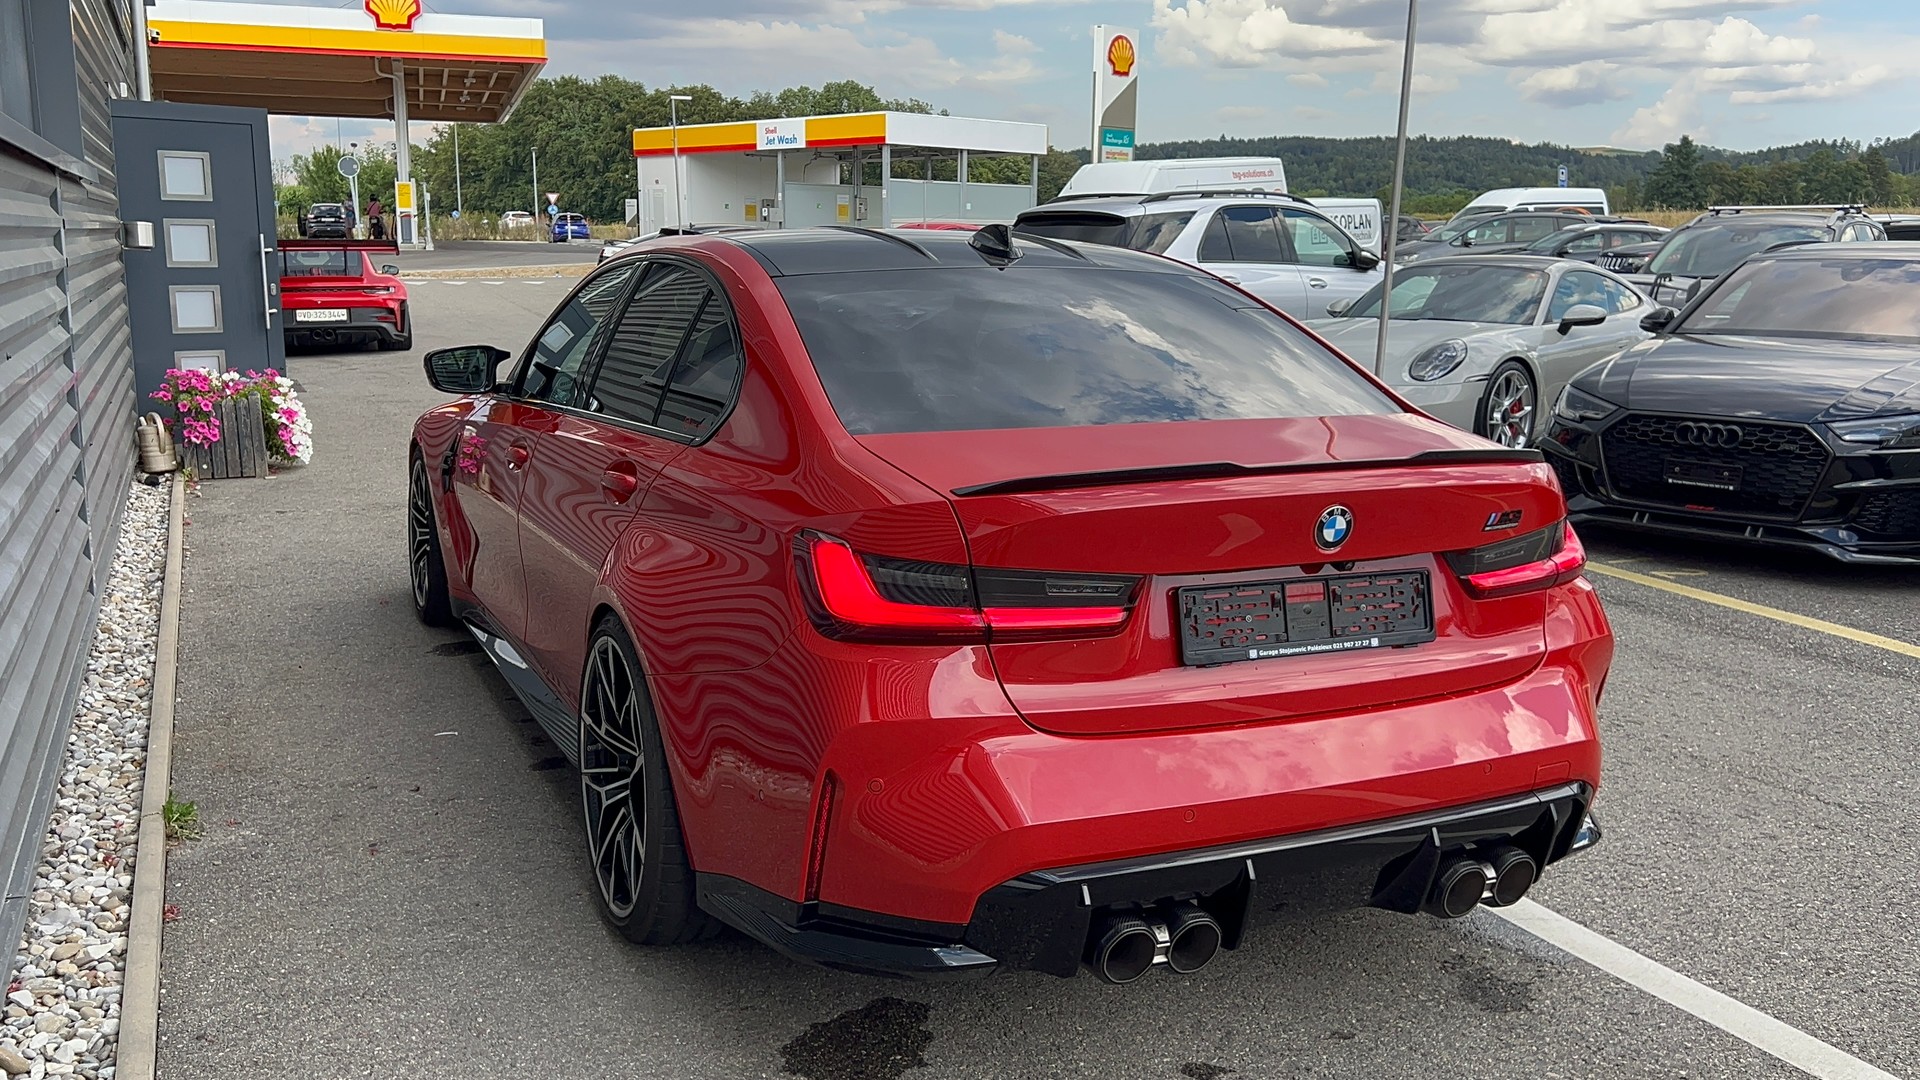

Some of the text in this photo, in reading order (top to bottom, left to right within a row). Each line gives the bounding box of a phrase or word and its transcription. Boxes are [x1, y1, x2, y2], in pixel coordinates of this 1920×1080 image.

[765, 126, 777, 135] Shell
[765, 133, 798, 146] Jet Wash
[1321, 507, 1352, 523] BMW
[1279, 646, 1307, 655] Stojanovic
[1307, 644, 1333, 652] Palézieux
[1344, 641, 1355, 649] 907
